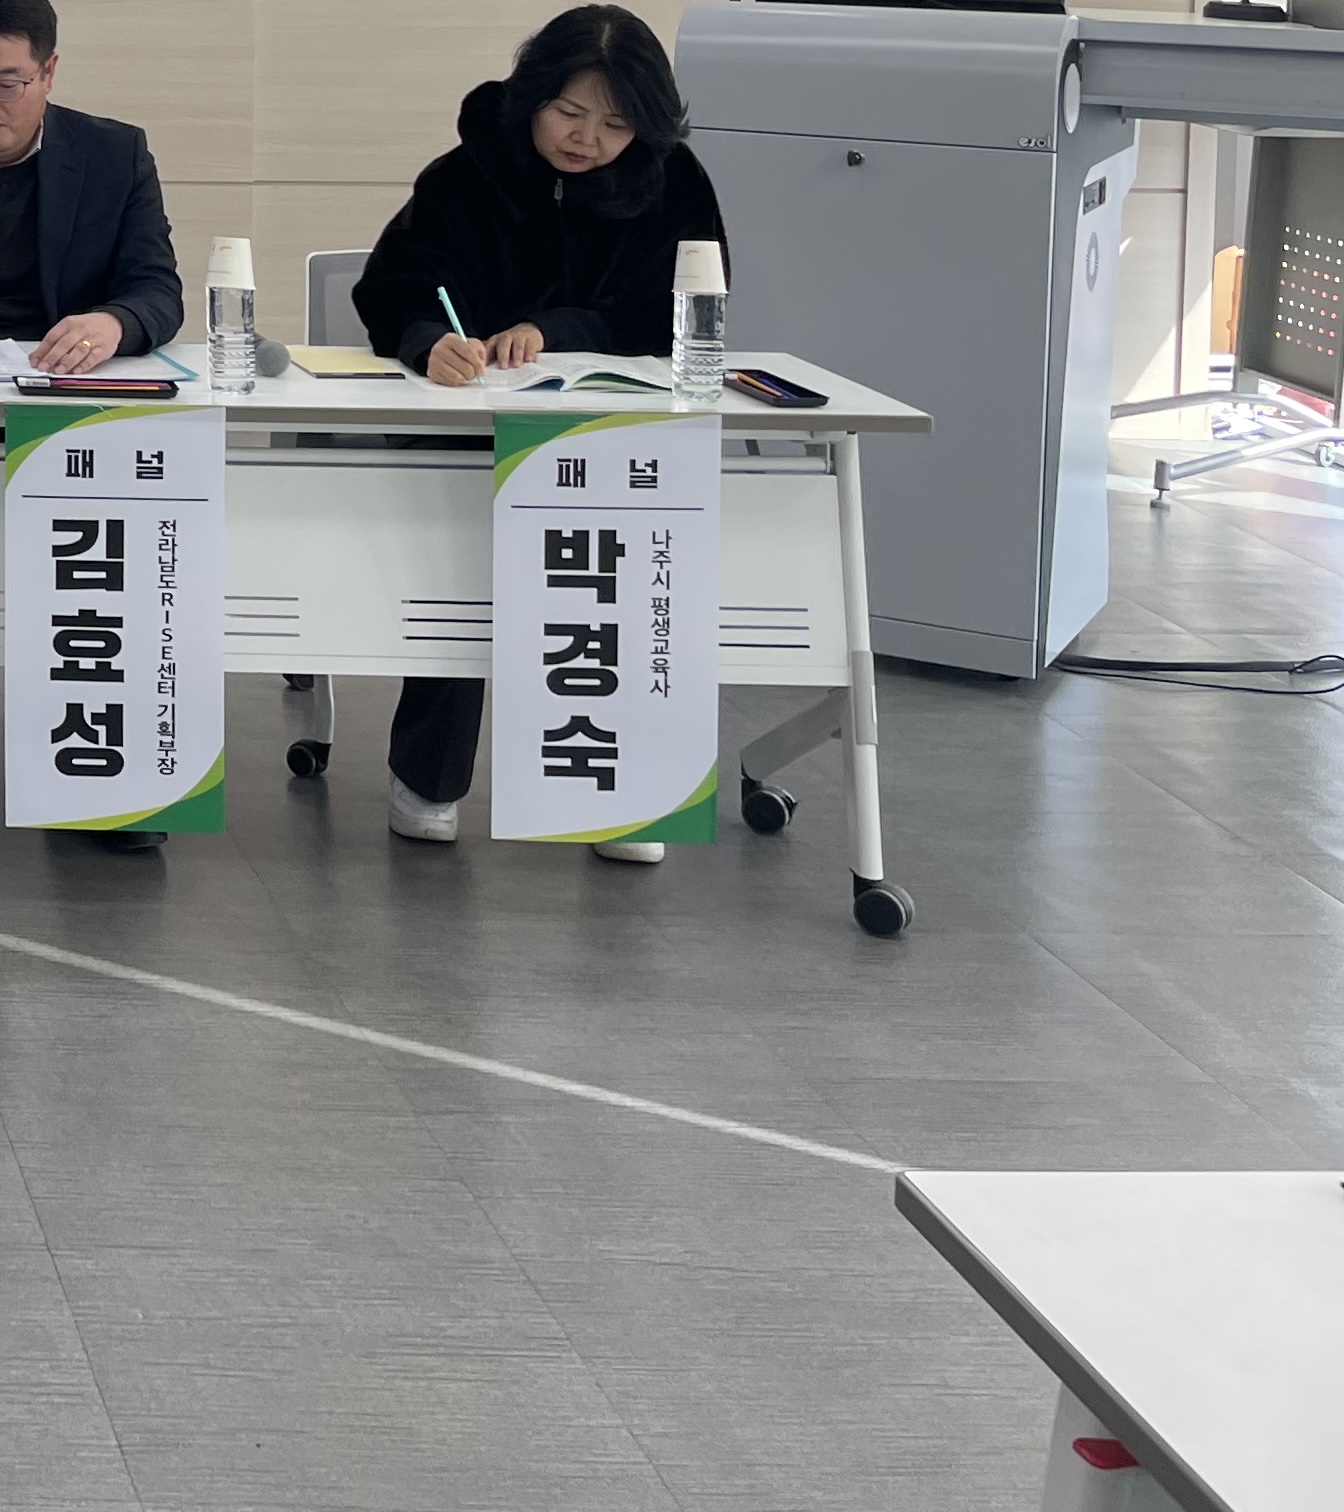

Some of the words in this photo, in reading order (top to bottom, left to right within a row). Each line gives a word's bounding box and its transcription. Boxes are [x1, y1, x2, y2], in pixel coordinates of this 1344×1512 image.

[156, 519, 178, 698] 전라남도RISE센터
[650, 529, 672, 591] 나주시
[50, 518, 125, 778] 김효성
[541, 528, 625, 792] 박경숙
[649, 596, 671, 699] 평생교육사
[156, 703, 177, 776] 기획부장
